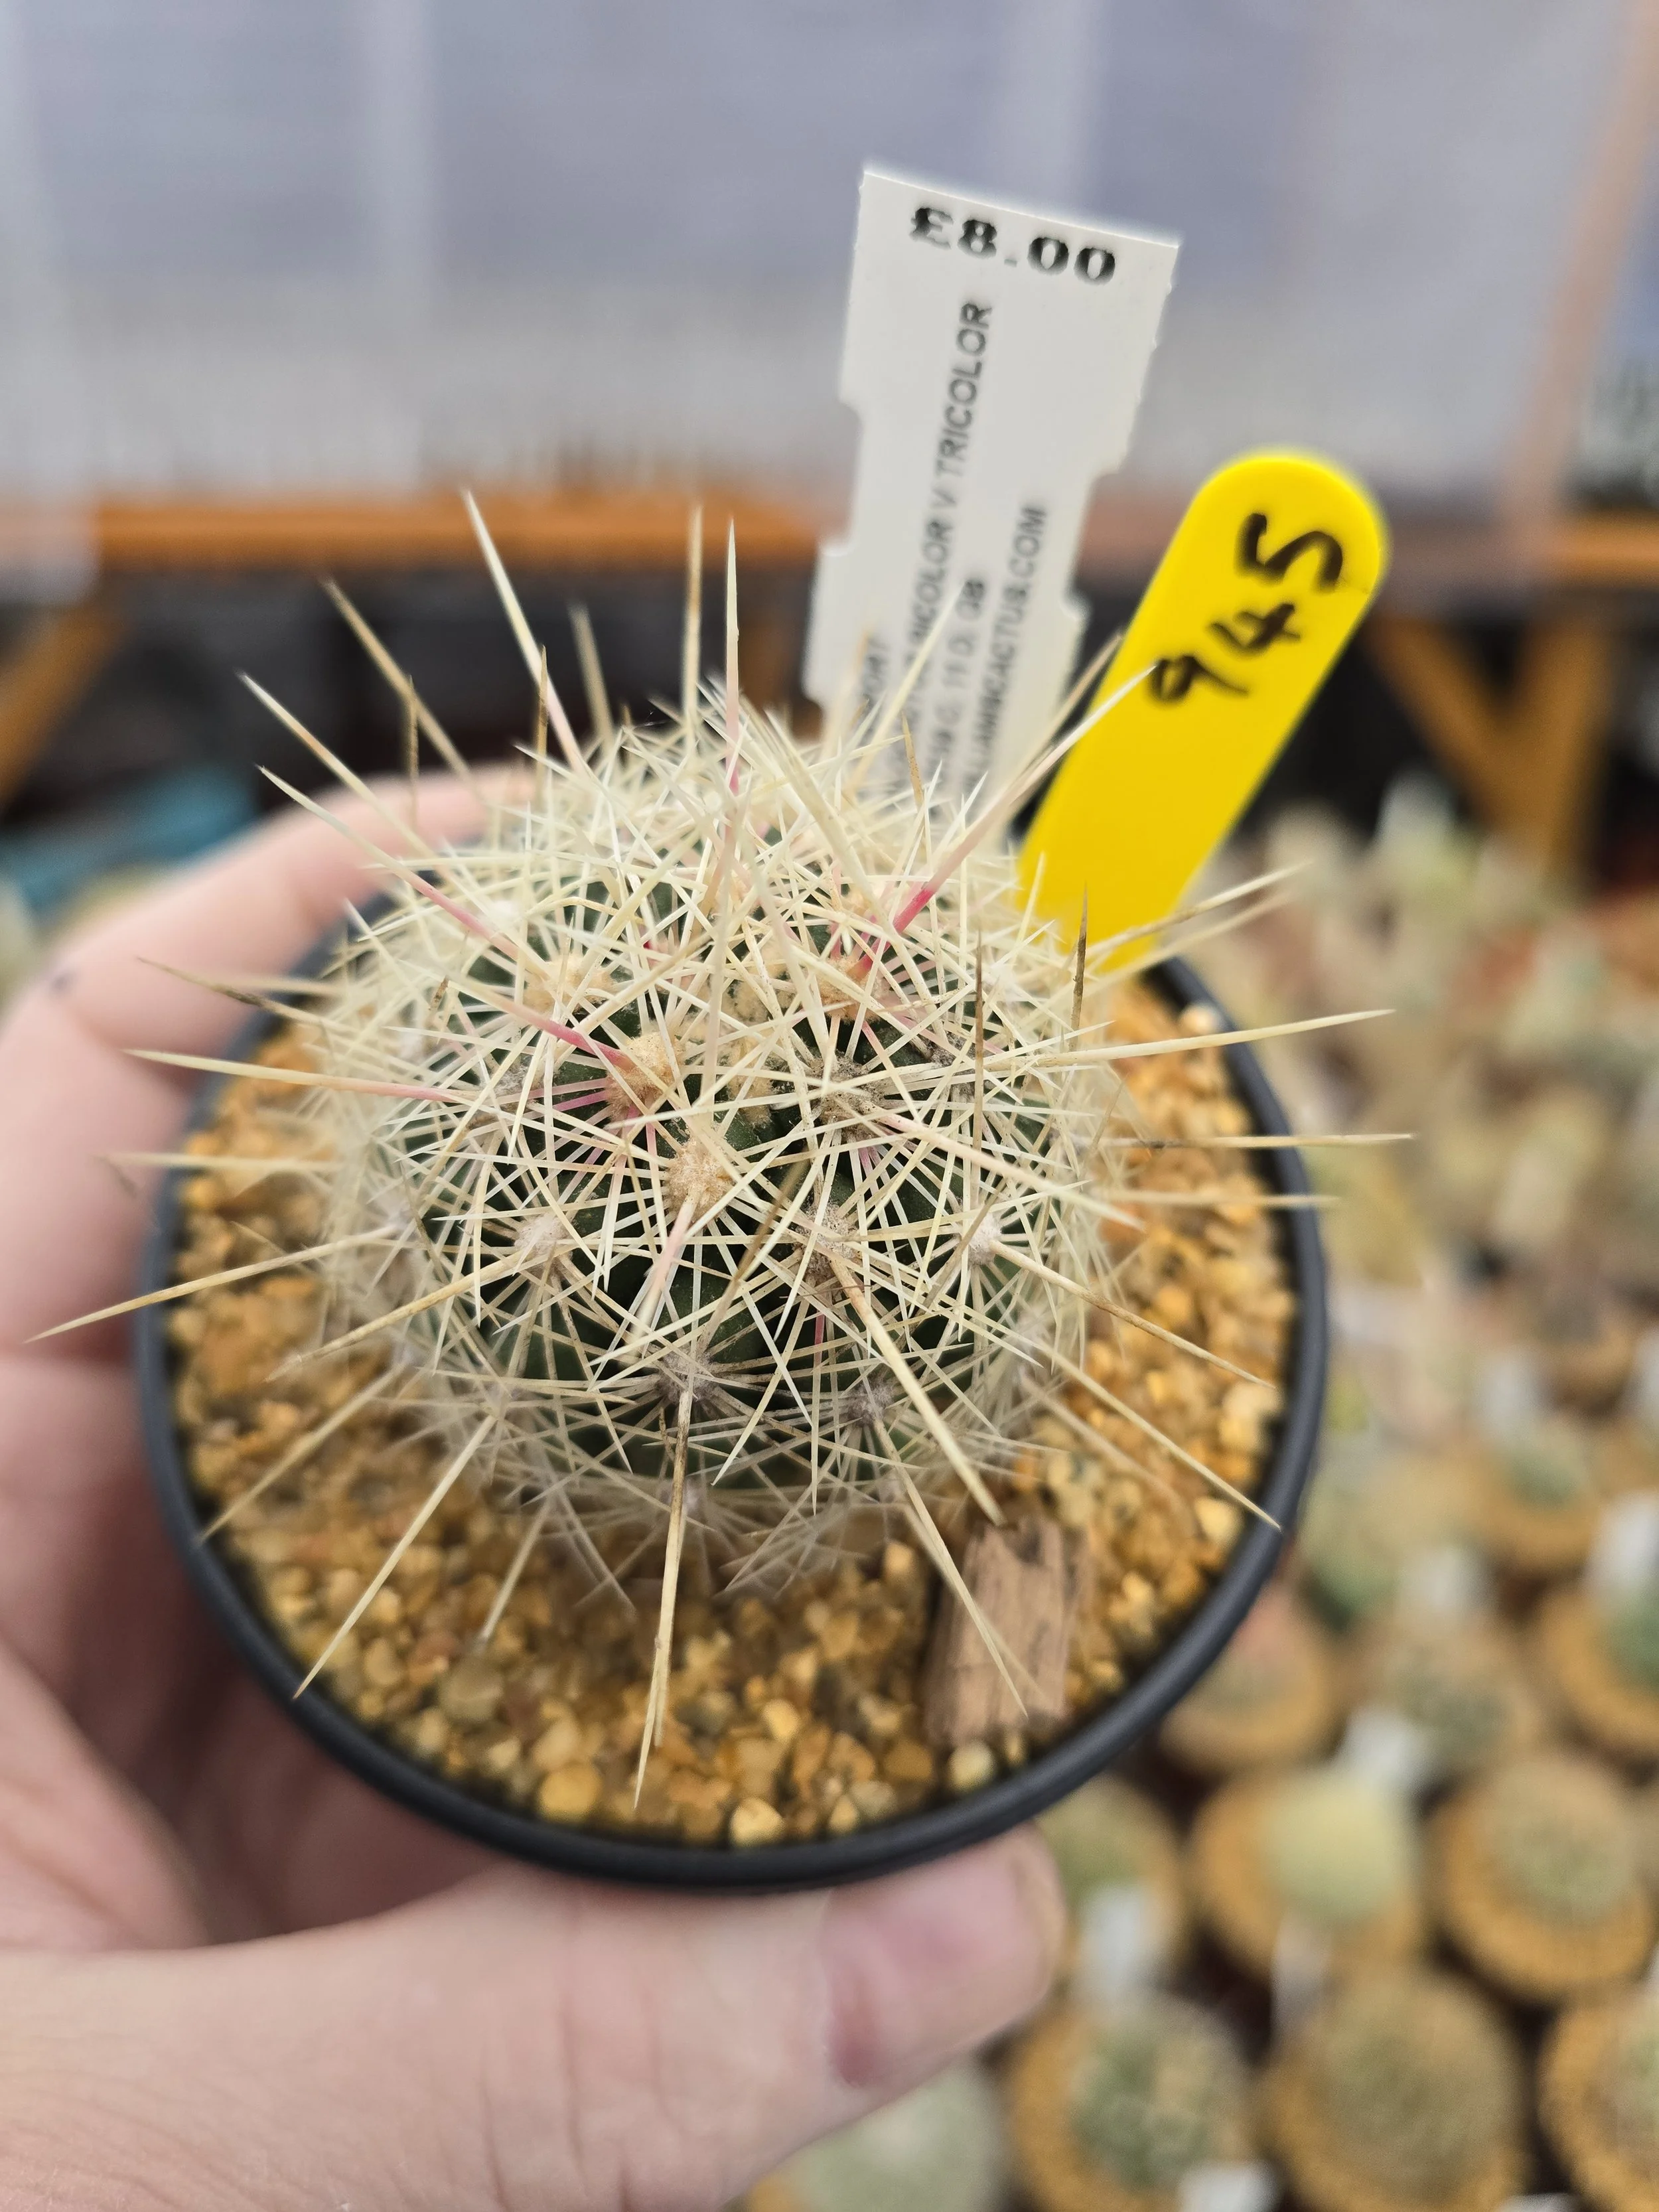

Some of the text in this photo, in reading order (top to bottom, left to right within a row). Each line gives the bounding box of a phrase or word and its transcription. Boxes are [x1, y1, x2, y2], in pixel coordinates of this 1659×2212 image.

[910, 206, 1116, 285] £8.00
[934, 302, 993, 477] TRICOLOR
[1148, 512, 1344, 708] 945
